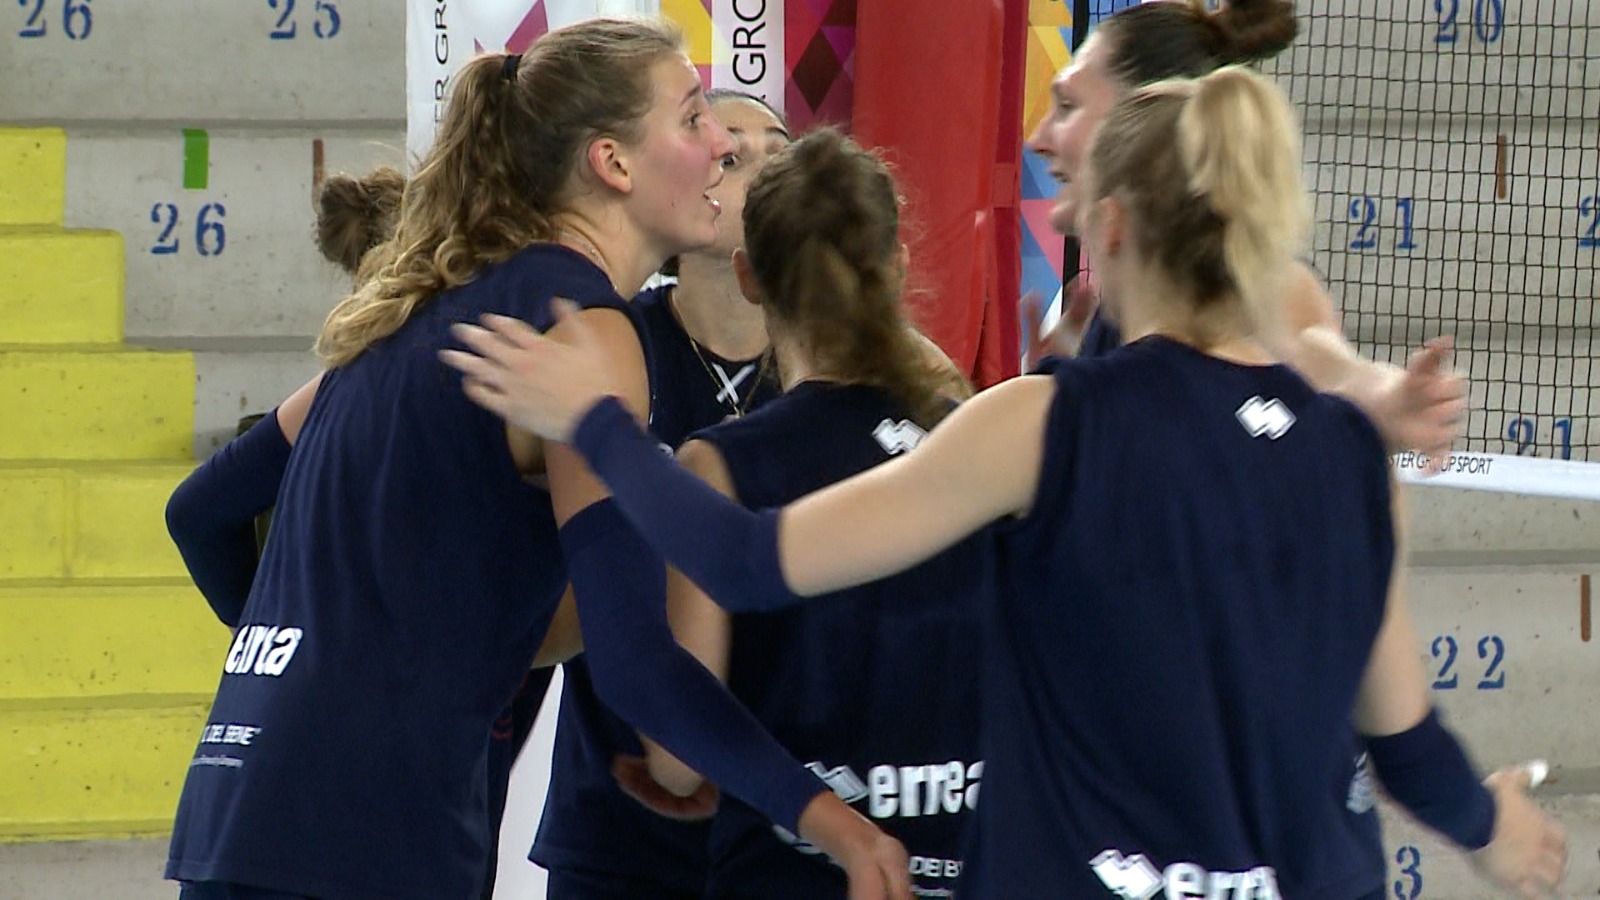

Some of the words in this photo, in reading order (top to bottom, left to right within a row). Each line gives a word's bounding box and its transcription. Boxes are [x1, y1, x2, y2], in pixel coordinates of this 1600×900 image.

[18, 0, 93, 40] 26
[268, 0, 341, 39] 25
[1433, 0, 1504, 43] 20
[150, 202, 226, 256] 26
[1350, 197, 1417, 249] 21
[1430, 635, 1505, 690] 22
